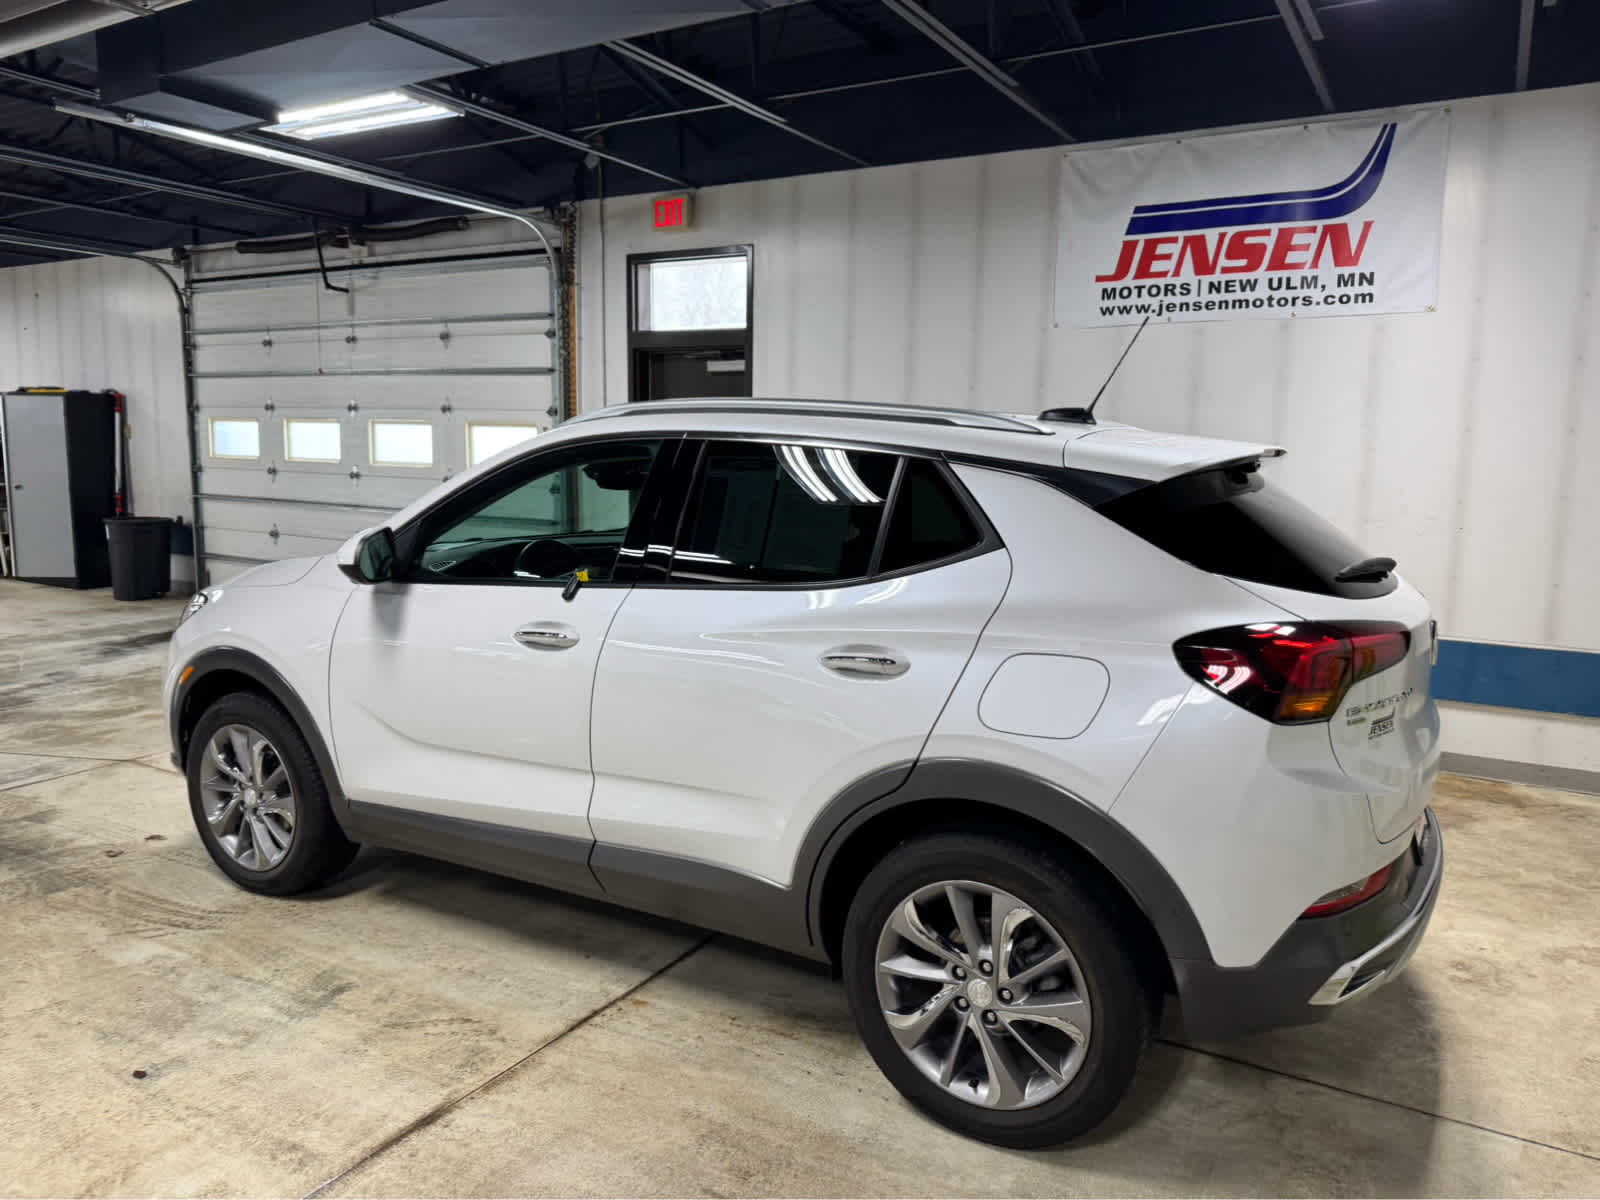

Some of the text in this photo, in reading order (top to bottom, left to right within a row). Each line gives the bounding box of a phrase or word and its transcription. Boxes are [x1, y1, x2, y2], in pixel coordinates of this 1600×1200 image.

[655, 197, 684, 228] EXIT
[1095, 220, 1375, 283] JENSEN
[1101, 271, 1375, 301] MOTORS NEW ULM, MN
[1100, 292, 1374, 317] www.jensenmotors.com
